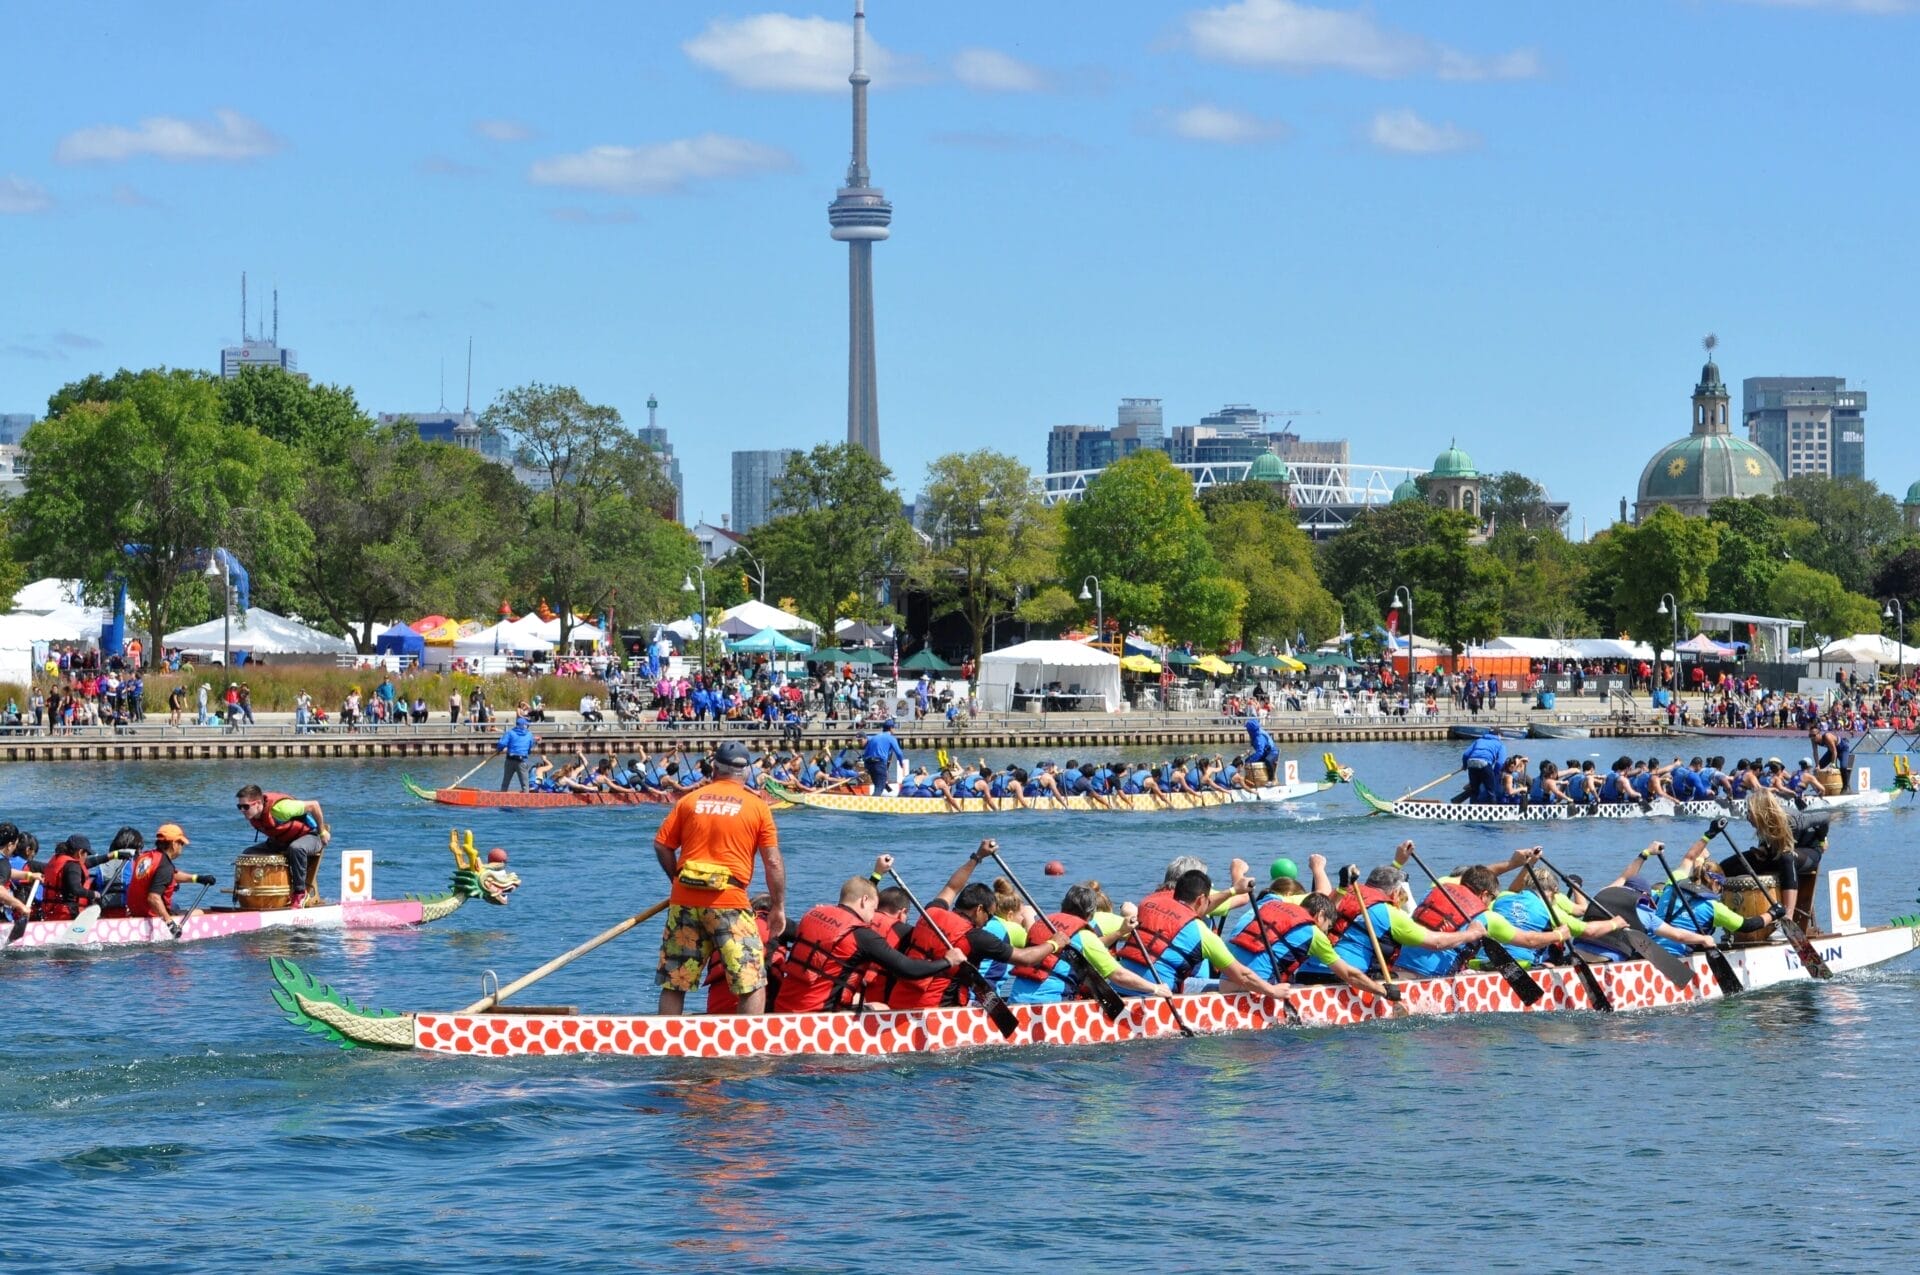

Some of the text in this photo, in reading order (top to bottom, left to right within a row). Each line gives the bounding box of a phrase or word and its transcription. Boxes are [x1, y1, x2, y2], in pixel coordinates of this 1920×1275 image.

[1288, 763, 1296, 780] 2
[1861, 771, 1868, 788] 3
[694, 803, 740, 817] STAFF
[349, 857, 365, 893] 5
[1836, 876, 1853, 921] 6
[809, 910, 843, 928] GWN
[1143, 901, 1182, 920] GWN
